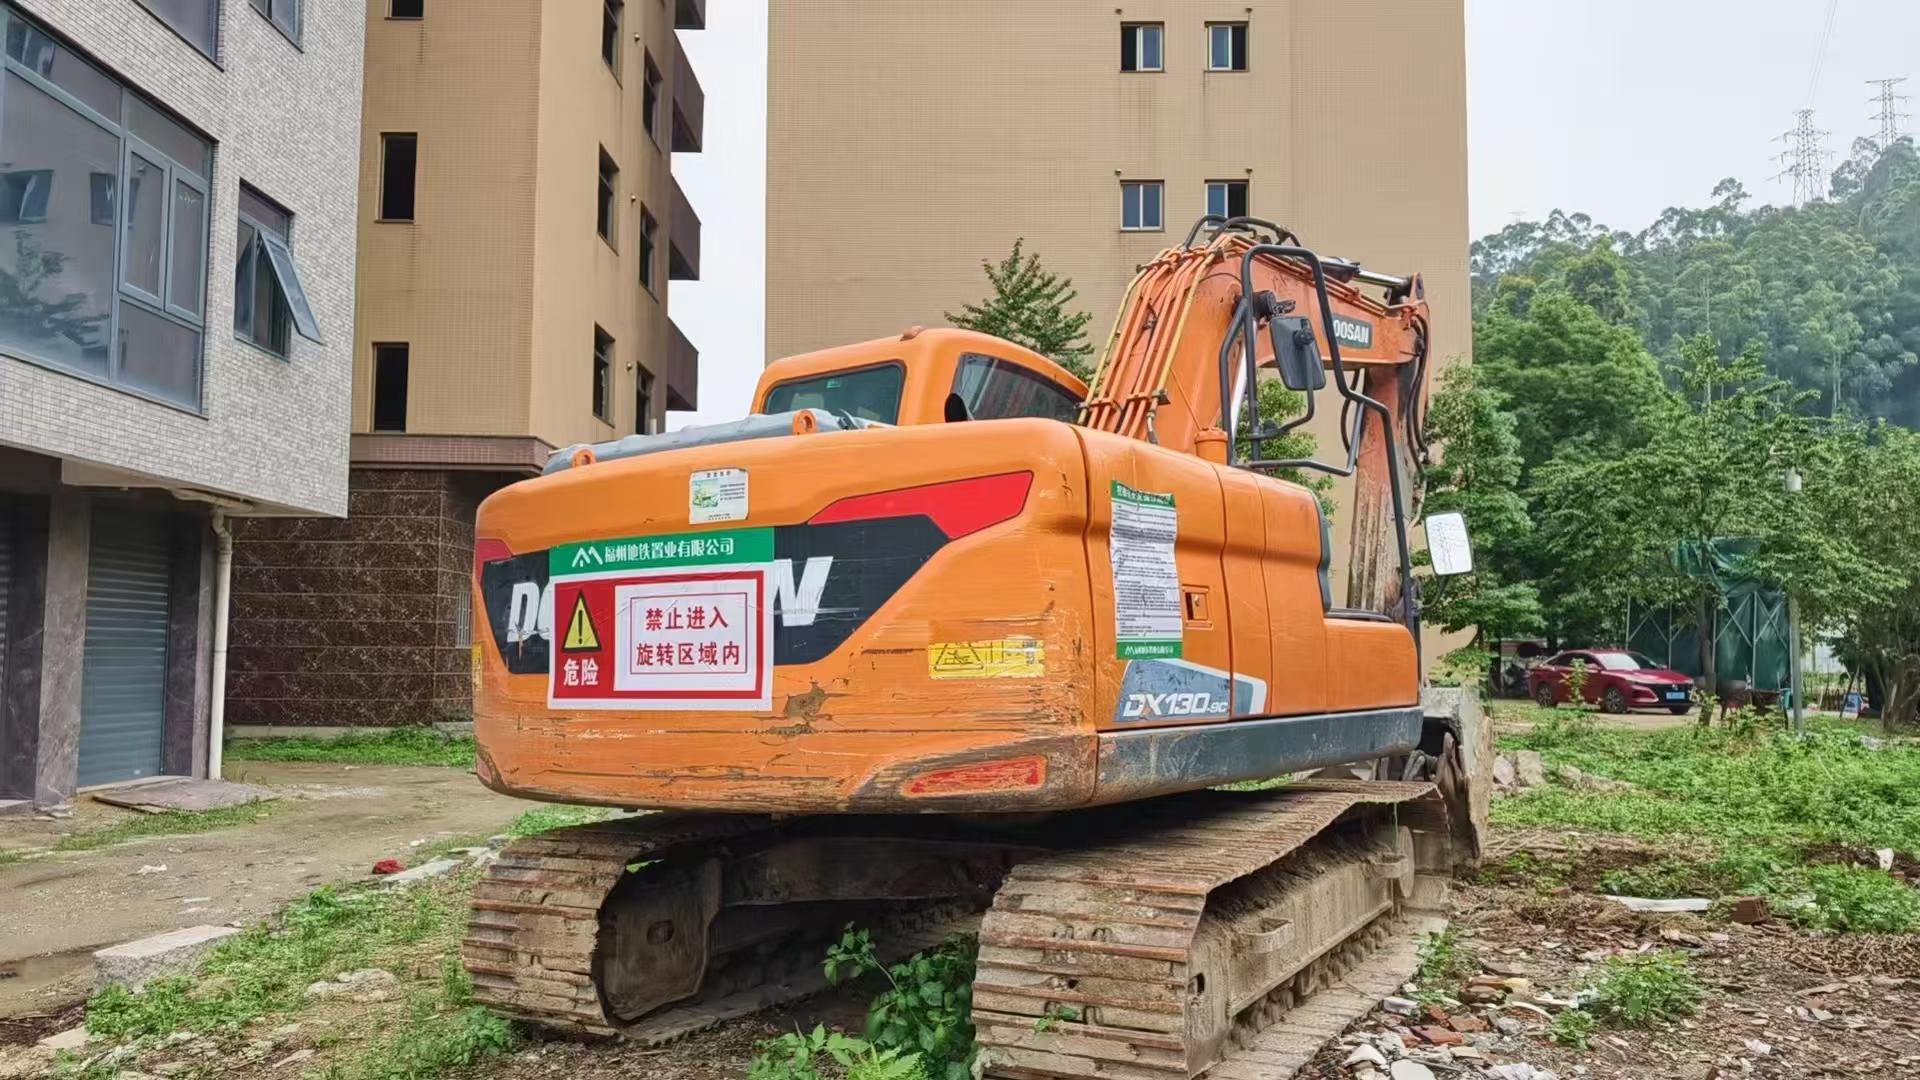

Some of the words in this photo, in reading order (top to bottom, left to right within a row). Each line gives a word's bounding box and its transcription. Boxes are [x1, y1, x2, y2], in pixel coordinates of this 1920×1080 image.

[1333, 319, 1369, 344] OOSAN
[604, 537, 734, 563] 福州地铁置业有限公司
[645, 606, 729, 632] 禁止进入
[636, 641, 740, 667] 旋转区域内
[563, 657, 599, 686] 危险
